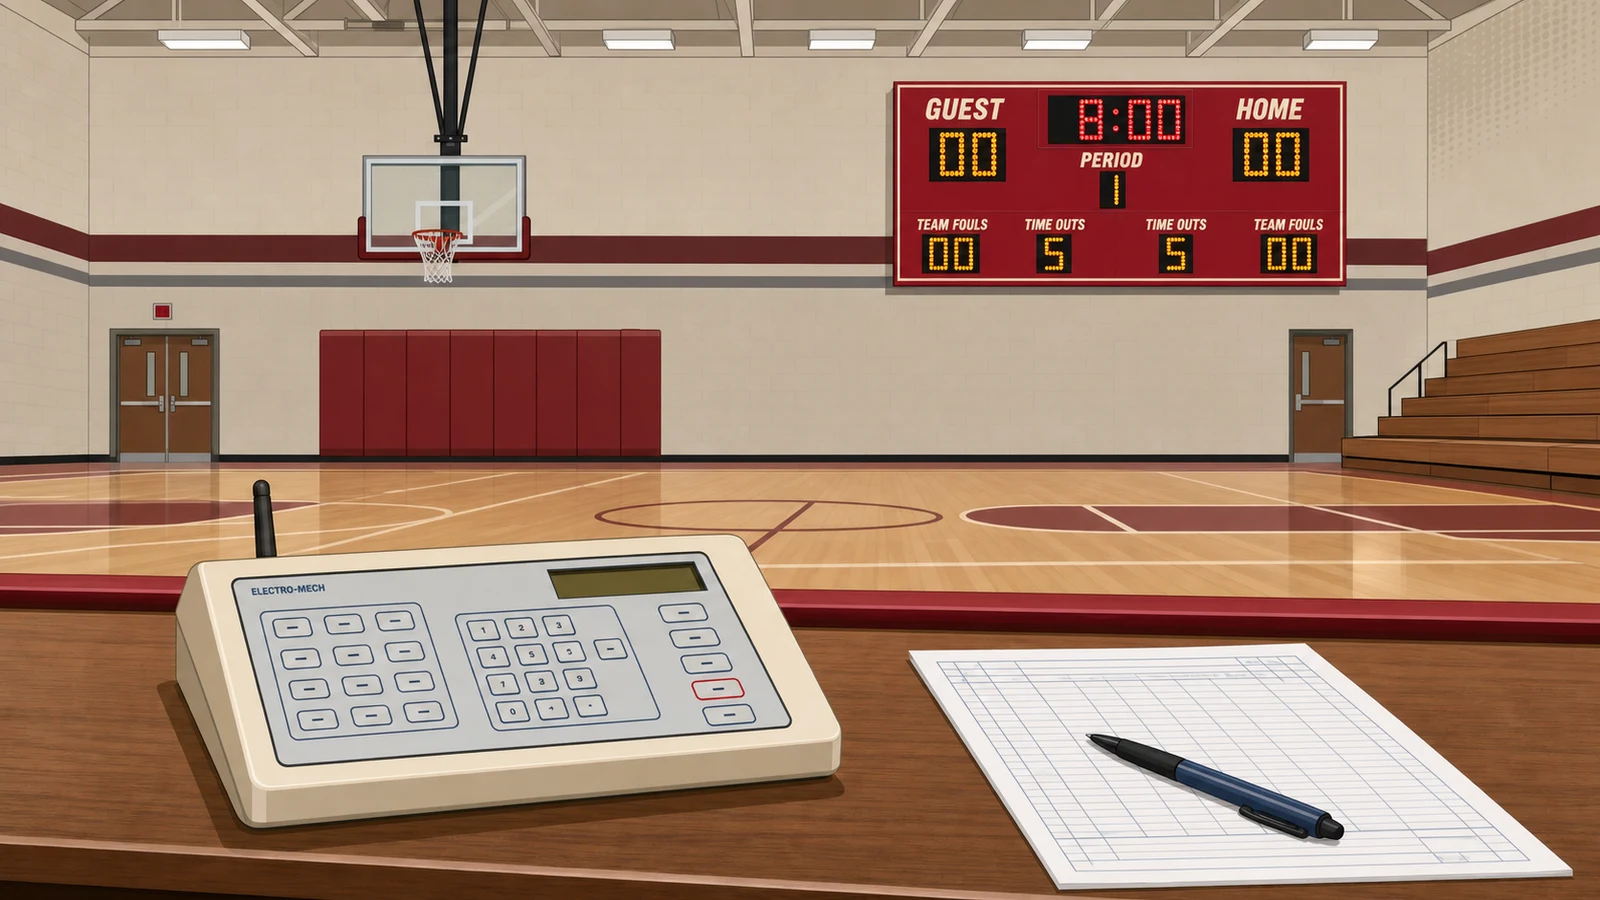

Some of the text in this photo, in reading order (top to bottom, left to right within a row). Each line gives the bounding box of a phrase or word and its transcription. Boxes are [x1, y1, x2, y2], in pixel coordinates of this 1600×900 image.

[925, 97, 1006, 121] GUEST
[1078, 98, 1182, 141] 8:00
[1235, 97, 1305, 121] HOME
[939, 131, 998, 177] 00
[1079, 151, 1144, 169] PERIOD
[1243, 131, 1301, 177] 00
[1112, 174, 1121, 206] 1
[917, 218, 989, 231] TEAM FOULS
[1024, 218, 1086, 231] TIME OUTS
[1145, 218, 1207, 231] TIME OUTS
[1254, 218, 1324, 231] TEAM FOULS
[928, 236, 974, 271] 00
[1044, 236, 1066, 271] 5
[1165, 236, 1187, 271] 5
[1266, 236, 1312, 271] 00
[251, 584, 326, 596] ELECTRO-MECH
